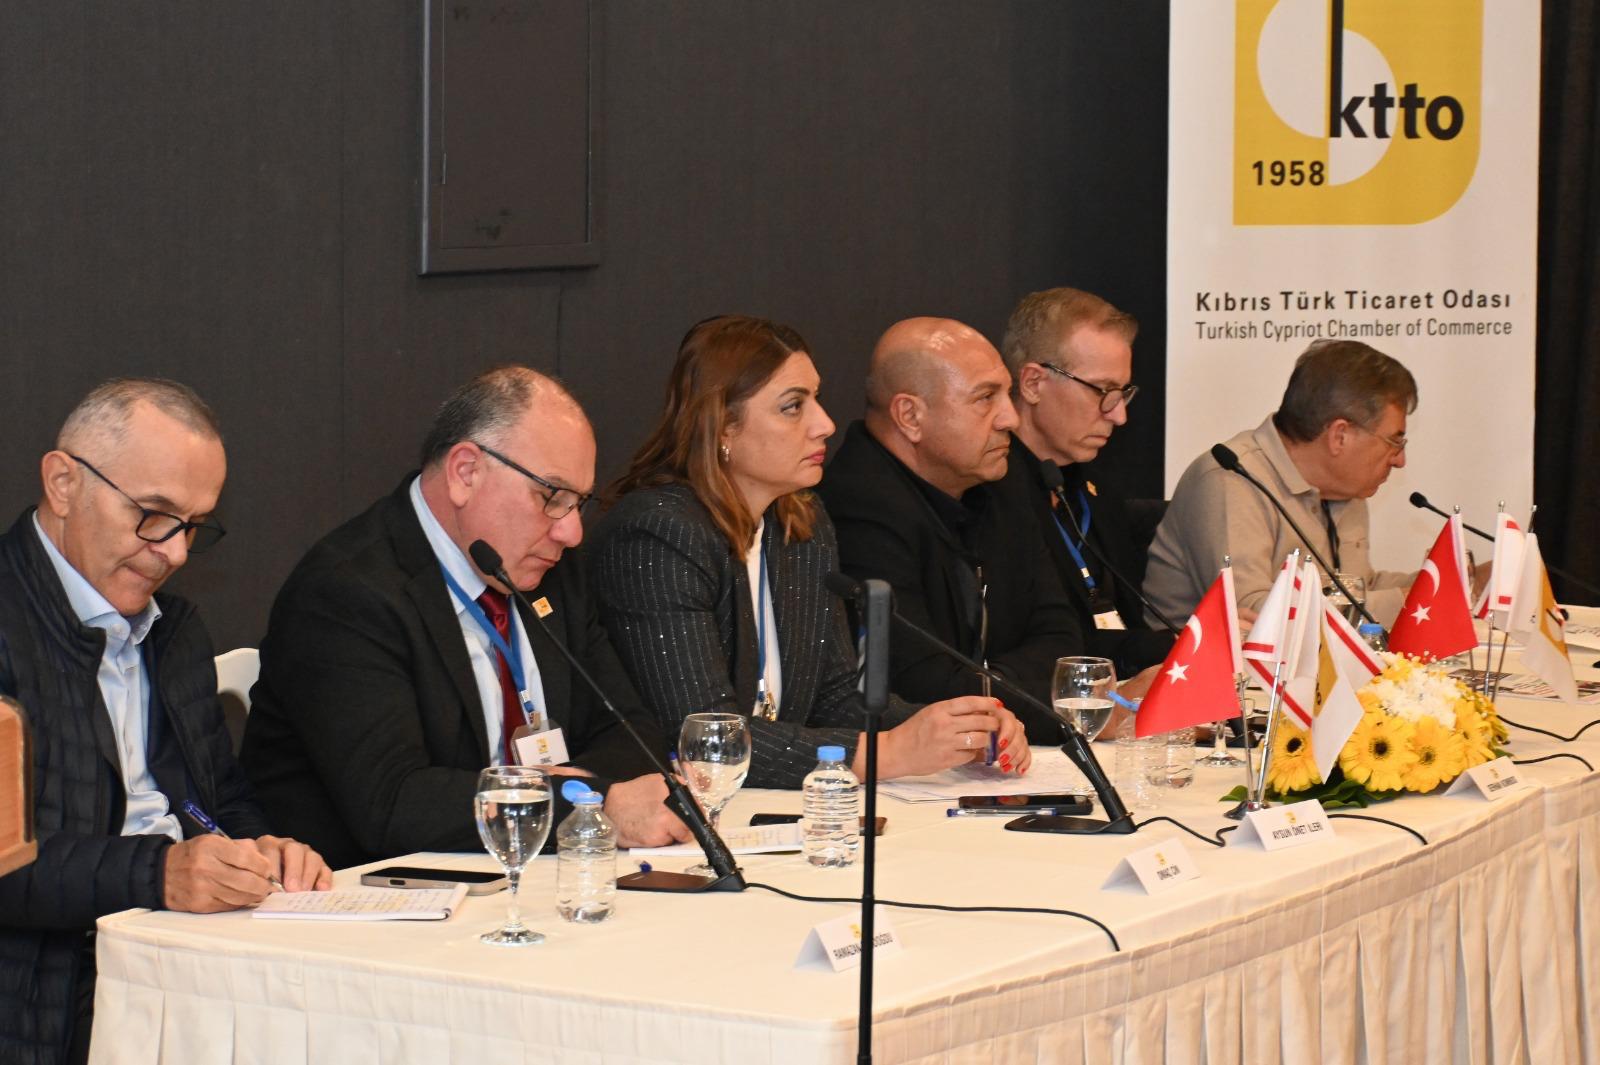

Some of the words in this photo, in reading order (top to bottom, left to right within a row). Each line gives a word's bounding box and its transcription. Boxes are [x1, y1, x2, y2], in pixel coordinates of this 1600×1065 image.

[1329, 82, 1464, 140] ktto
[1252, 160, 1325, 187] 1958
[1196, 292, 1271, 312] Kıbrıs
[1279, 290, 1336, 311] Türk
[1344, 290, 1434, 310] Ticaret
[1442, 289, 1511, 309] Odası
[1195, 320, 1258, 340] Turkish
[1263, 319, 1323, 342] Cypriot
[1327, 318, 1401, 338] Chamber
[1405, 318, 1422, 337] of
[1426, 317, 1513, 337] Commerce
